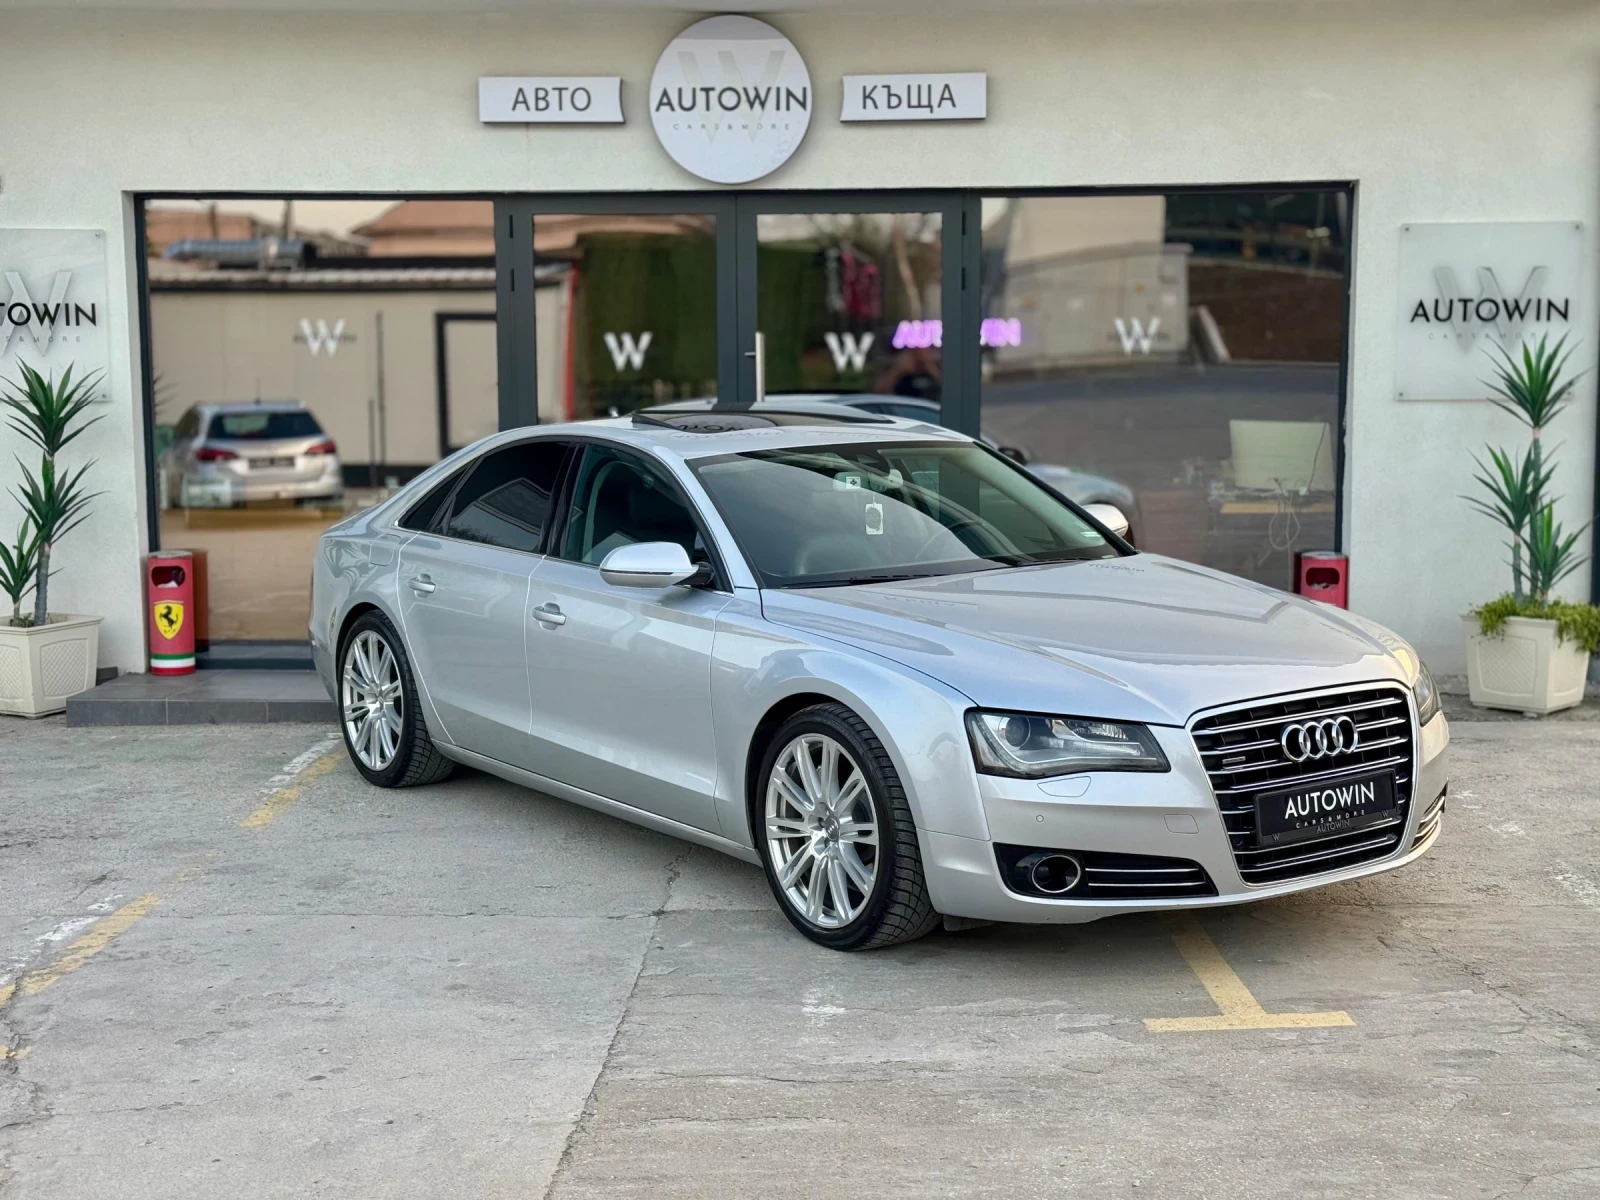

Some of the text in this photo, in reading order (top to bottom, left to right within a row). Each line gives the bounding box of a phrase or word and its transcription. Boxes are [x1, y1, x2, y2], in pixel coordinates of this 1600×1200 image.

[511, 87, 591, 111] АВТО
[655, 86, 807, 112] AUTOWIN
[862, 83, 956, 114] КЪЩА
[1410, 298, 1569, 323] AUTOWIN
[604, 331, 653, 372] W
[824, 331, 875, 373] W
[1285, 782, 1375, 819] AUTOWIN
[1316, 818, 1350, 834] AUTOWIN
